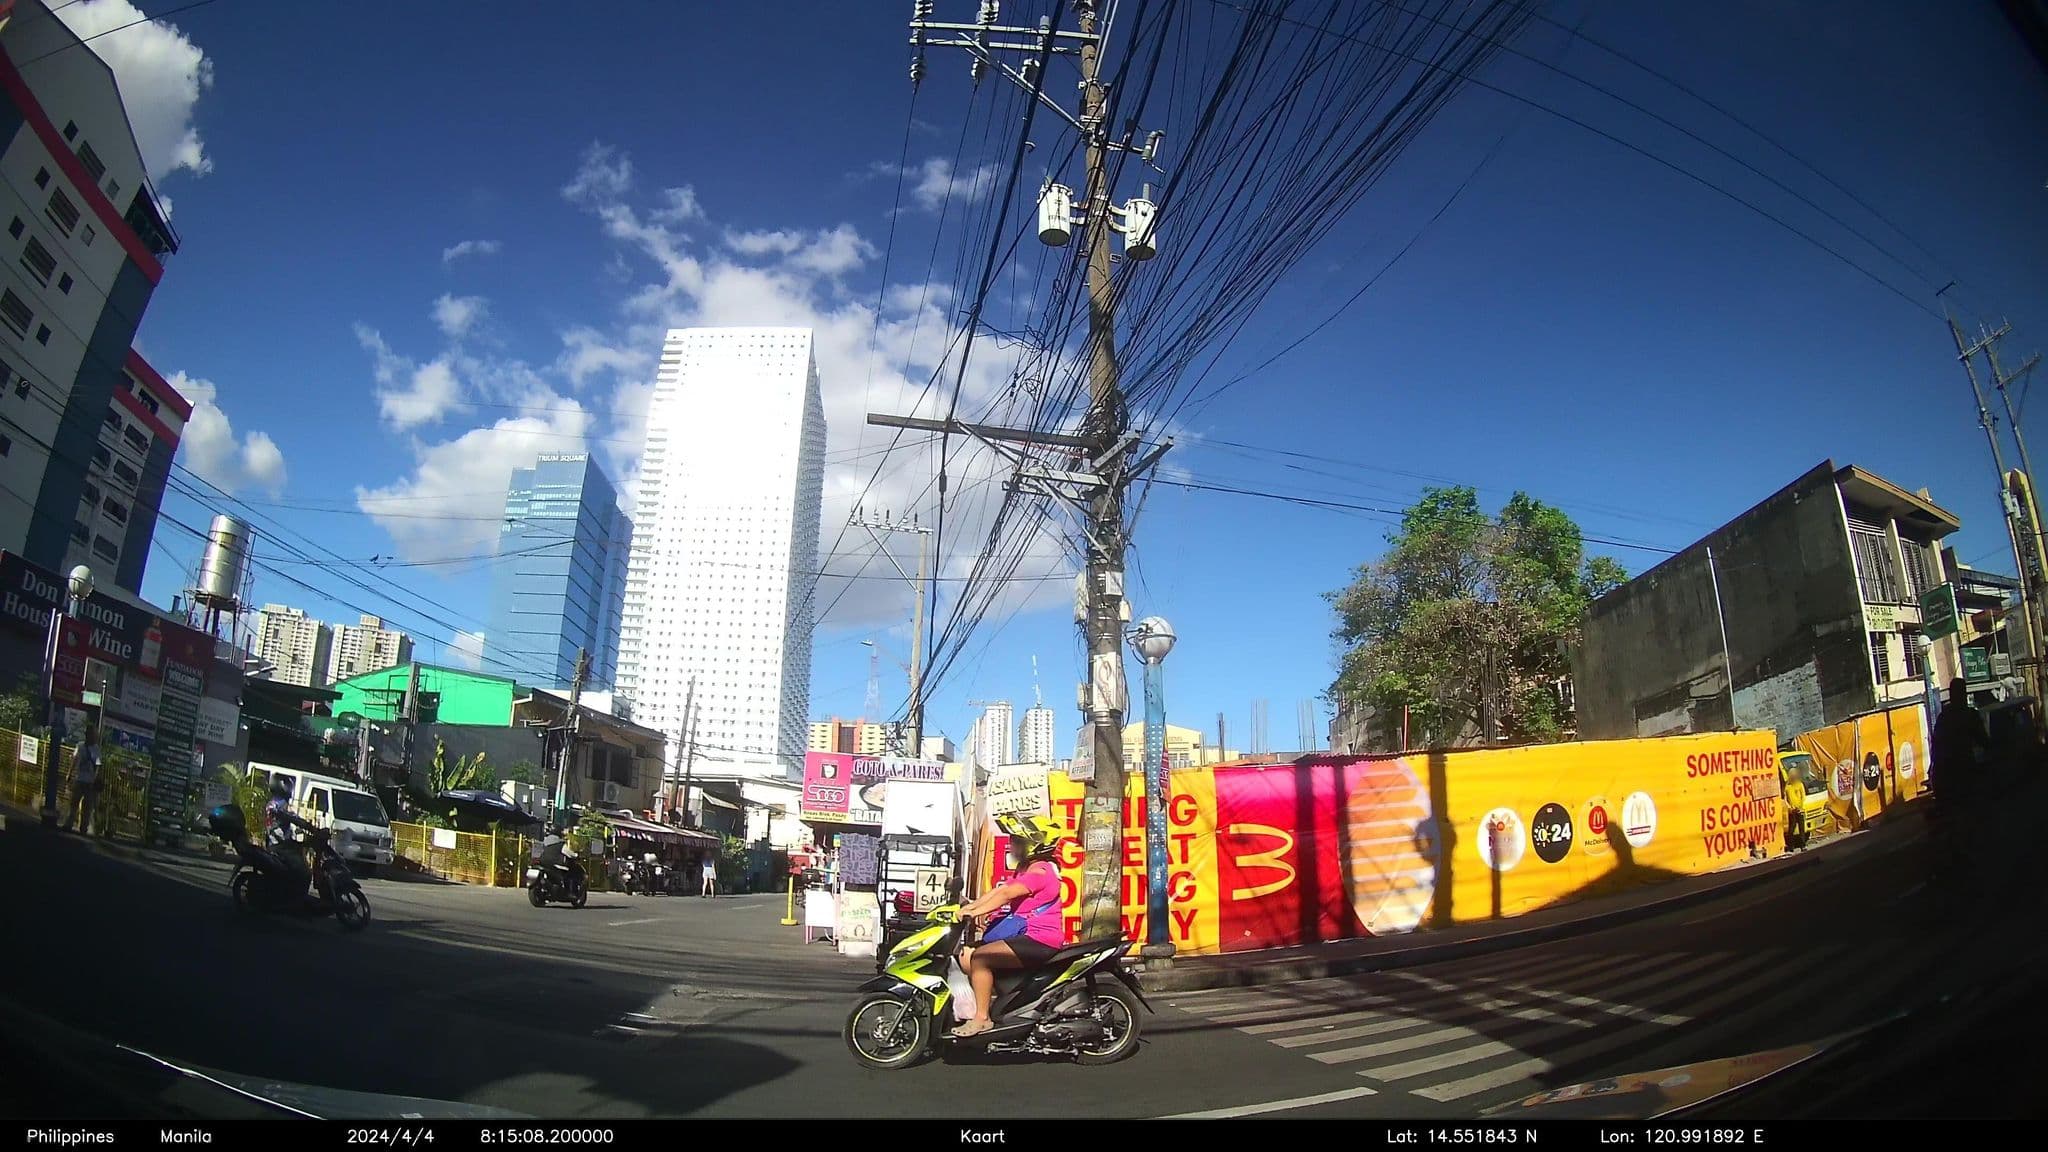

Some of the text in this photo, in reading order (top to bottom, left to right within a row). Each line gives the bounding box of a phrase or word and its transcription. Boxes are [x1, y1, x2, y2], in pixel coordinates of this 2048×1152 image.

[560, 454, 586, 462] SQUARE
[22, 569, 58, 602] Don
[3, 591, 132, 659] Hous Wine
[1881, 606, 1893, 616] SALE
[854, 759, 886, 777] GOTO
[1687, 747, 1774, 778] SOMETHING
[1701, 799, 1776, 832] IS COMING
[1704, 821, 1777, 858] YOUR WAY
[926, 873, 942, 893] 4
